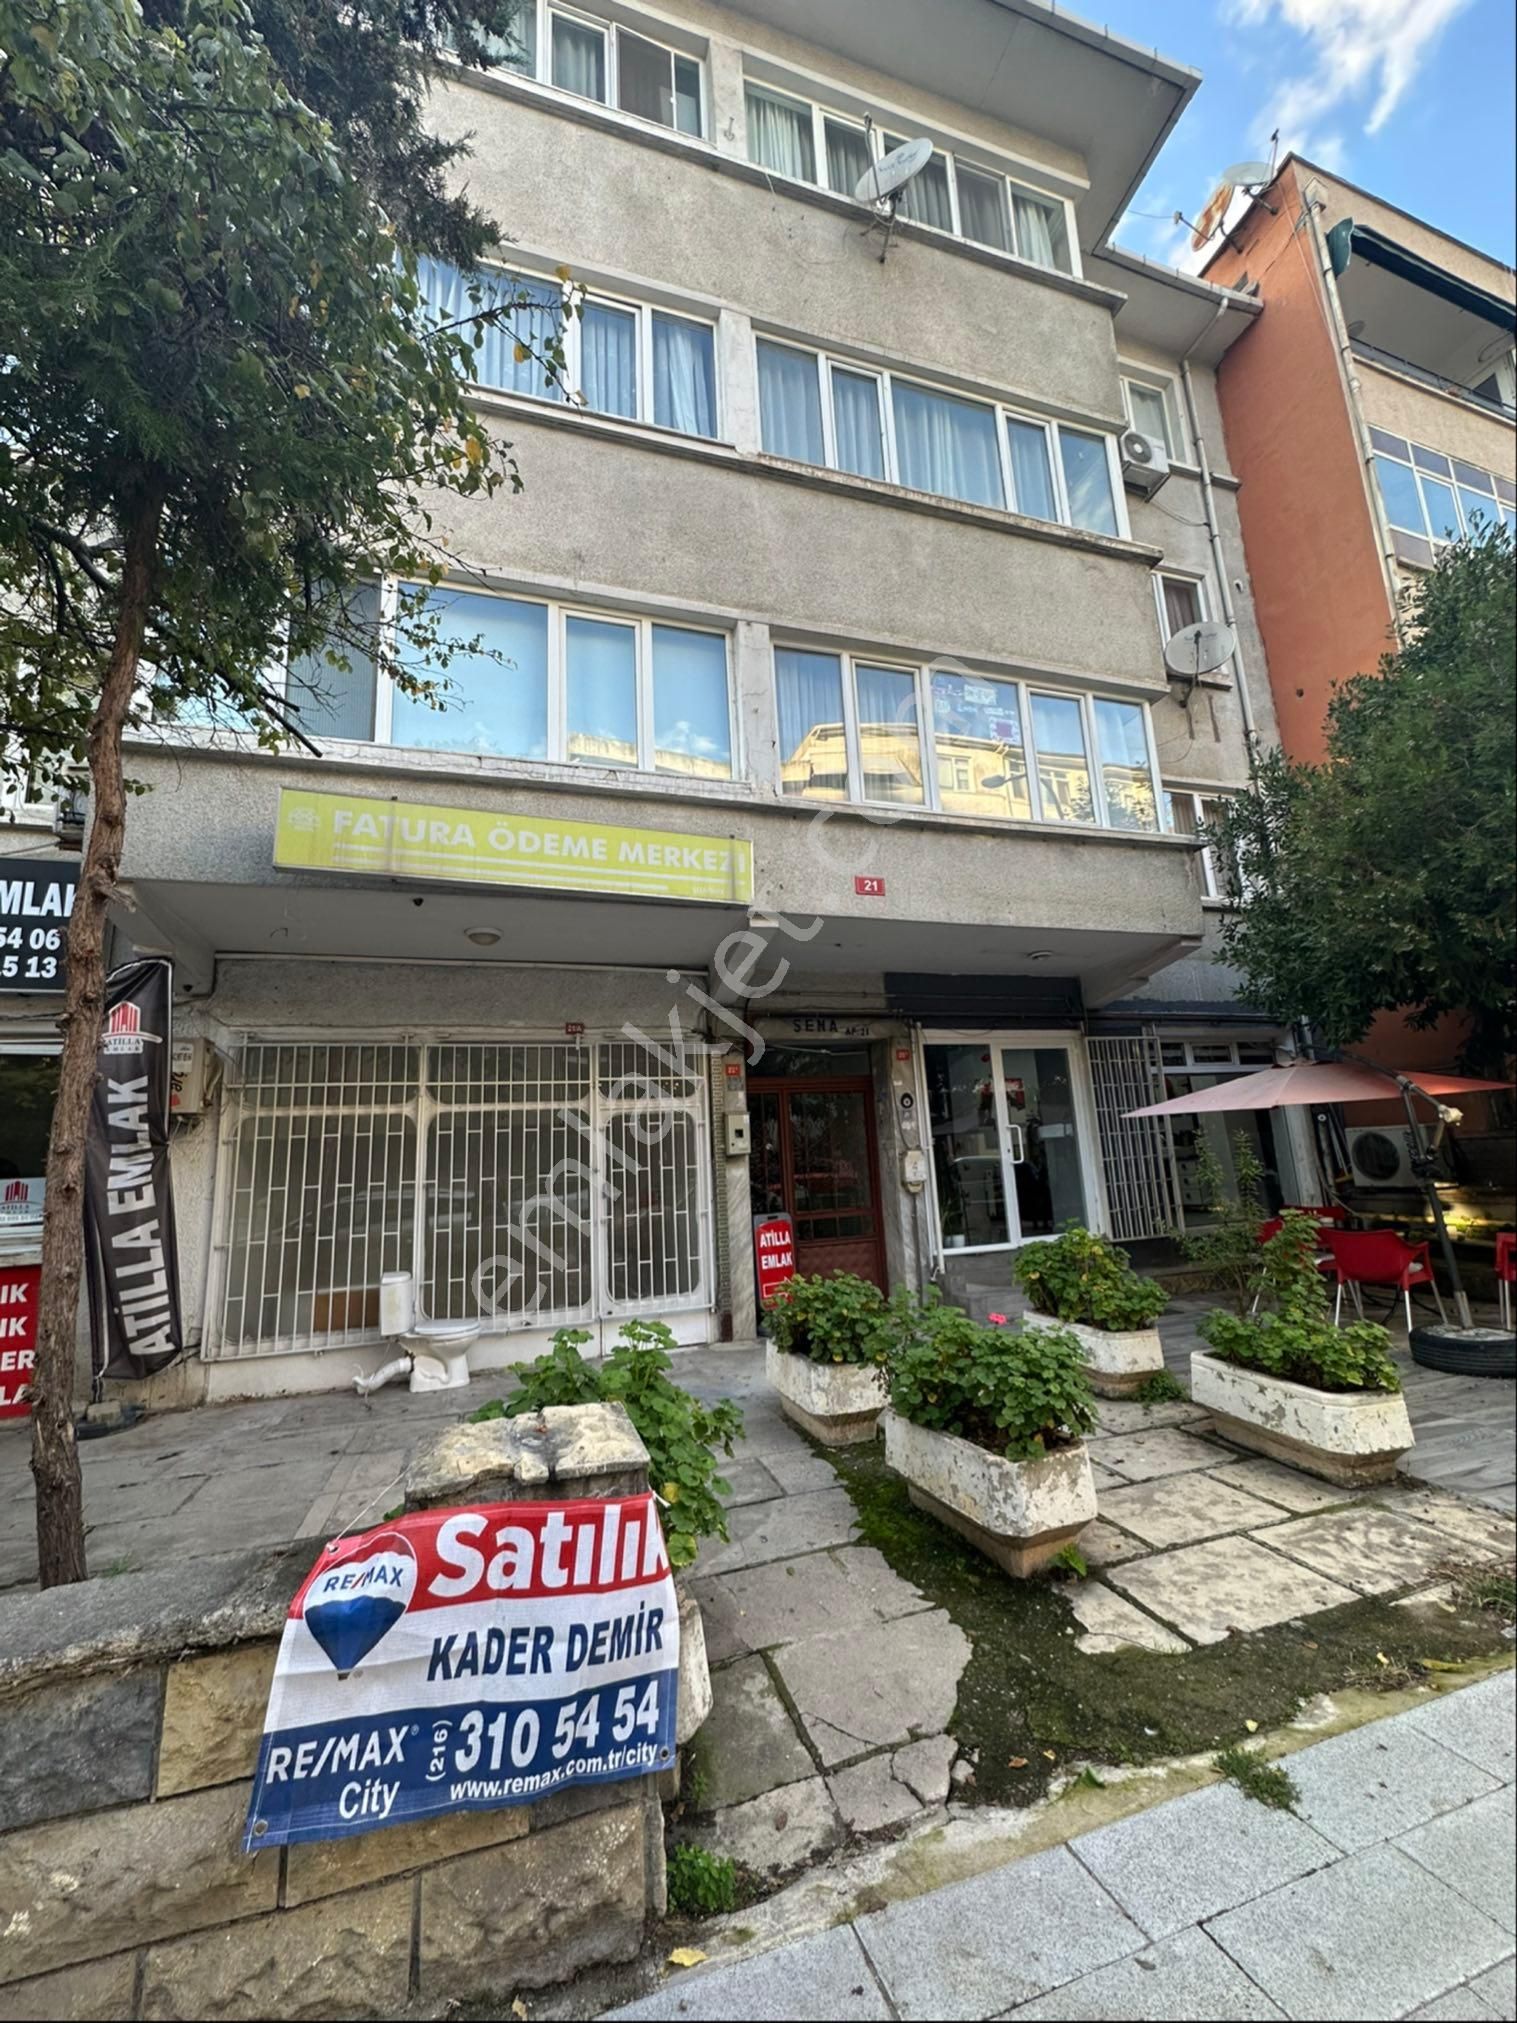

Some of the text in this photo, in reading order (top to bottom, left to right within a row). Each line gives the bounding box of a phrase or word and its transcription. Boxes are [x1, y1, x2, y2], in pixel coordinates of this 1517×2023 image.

[333, 809, 476, 848] FATURA
[488, 821, 607, 862] ÖDEME
[863, 879, 879, 891] 21
[29, 927, 61, 951] 06
[24, 956, 58, 979] 13
[106, 1075, 176, 1355] ATİLLA EMLAK
[760, 1229, 791, 1248] ATİLLA
[761, 1252, 793, 1270] EMLAK
[324, 1564, 404, 1593] RE/MAX
[427, 1600, 665, 1682] KADER DEMİR
[455, 1709, 542, 1773] 310
[552, 1695, 600, 1760] 54
[613, 1680, 660, 1743] 54
[450, 1740, 659, 1802] www.remax.com.tr/city
[338, 1779, 401, 1820] City
